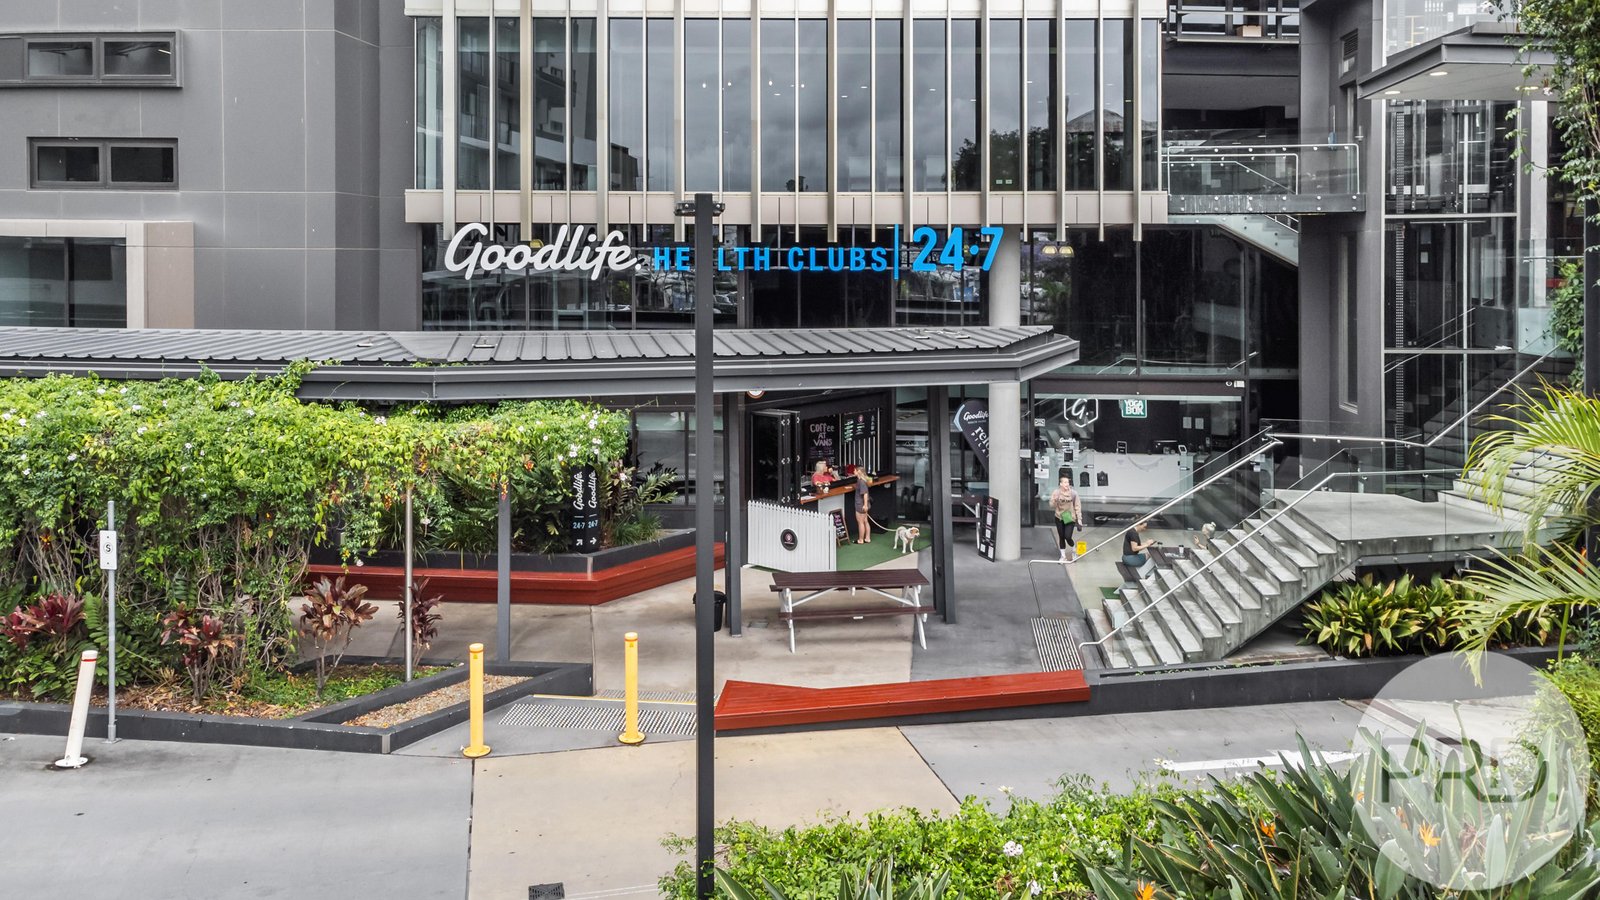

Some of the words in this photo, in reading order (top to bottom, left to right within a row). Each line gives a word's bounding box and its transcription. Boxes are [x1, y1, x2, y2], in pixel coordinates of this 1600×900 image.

[653, 246, 770, 271] HELTH
[787, 246, 888, 272] CLUBS
[813, 439, 832, 447] VANS
[105, 544, 111, 552] S
